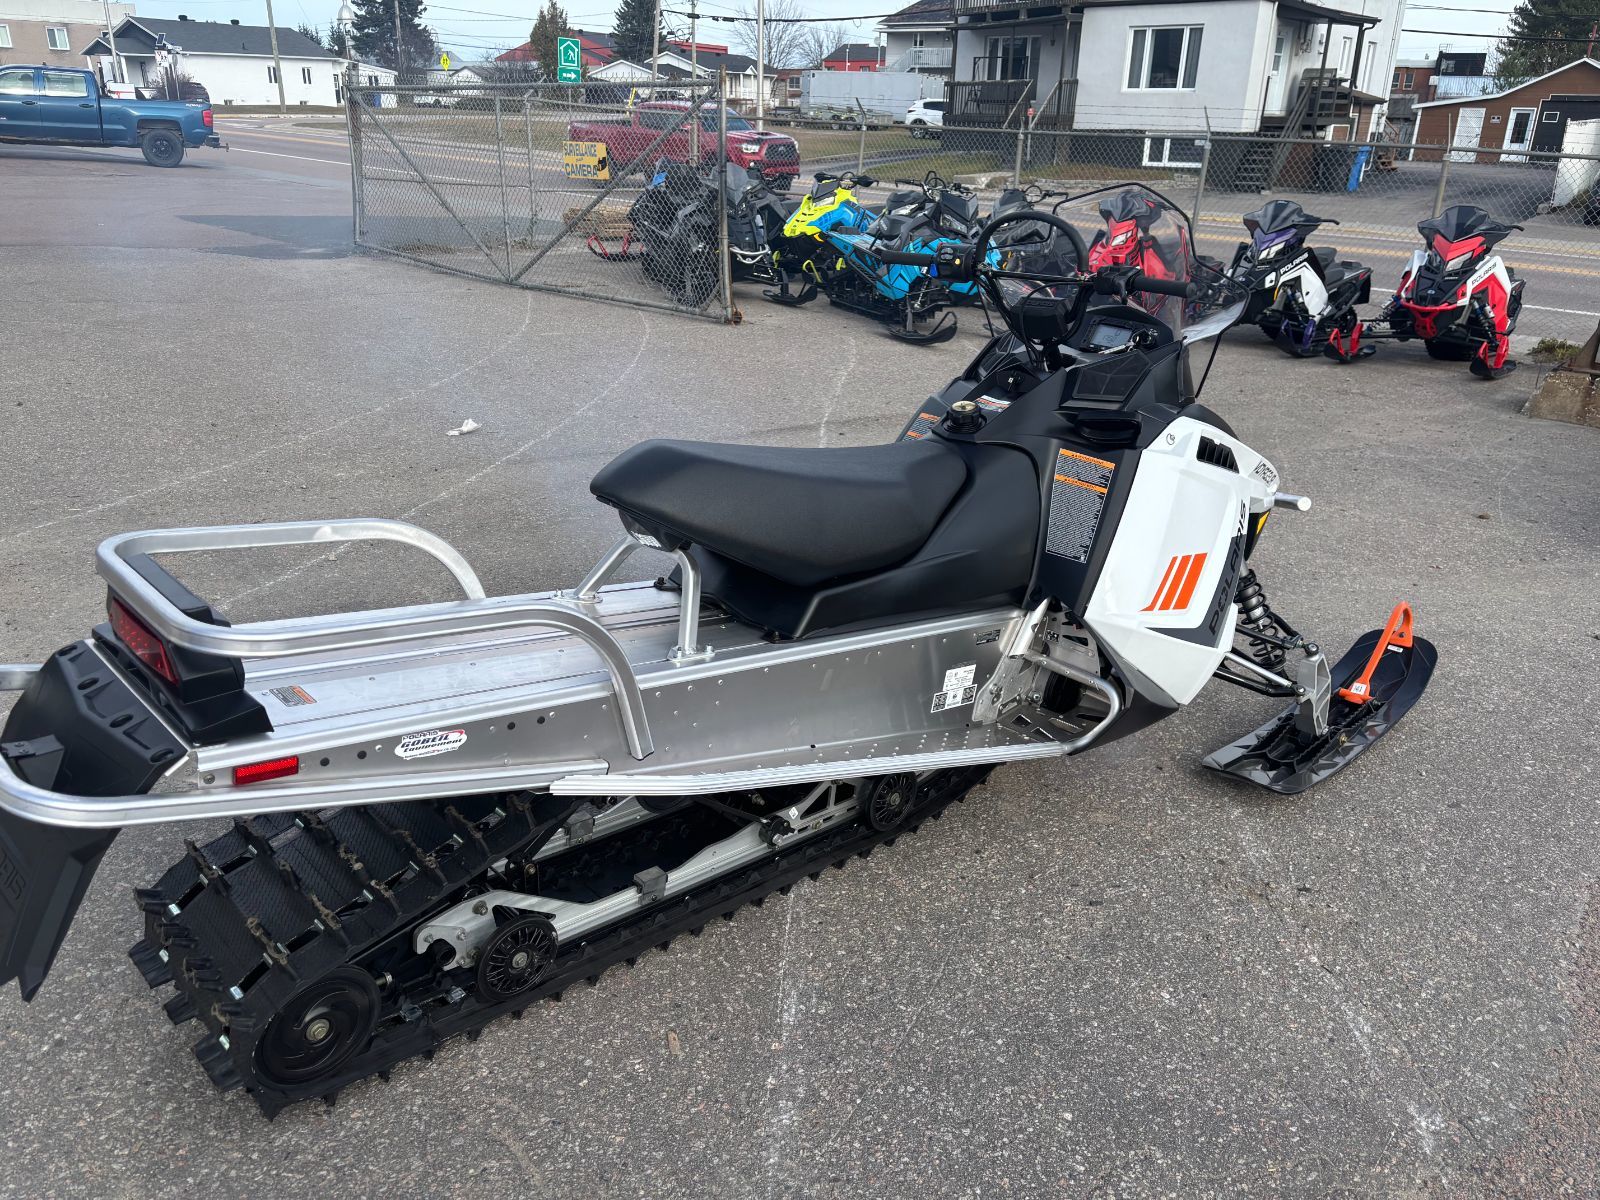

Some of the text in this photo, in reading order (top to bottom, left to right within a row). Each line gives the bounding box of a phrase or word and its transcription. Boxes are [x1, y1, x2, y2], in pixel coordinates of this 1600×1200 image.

[1280, 252, 1309, 275] POLARIS
[1471, 262, 1497, 286] POLARIS
[1209, 499, 1246, 635] POLARIS
[401, 734, 450, 749] GOBEIL
[402, 730, 440, 741] POLARIS
